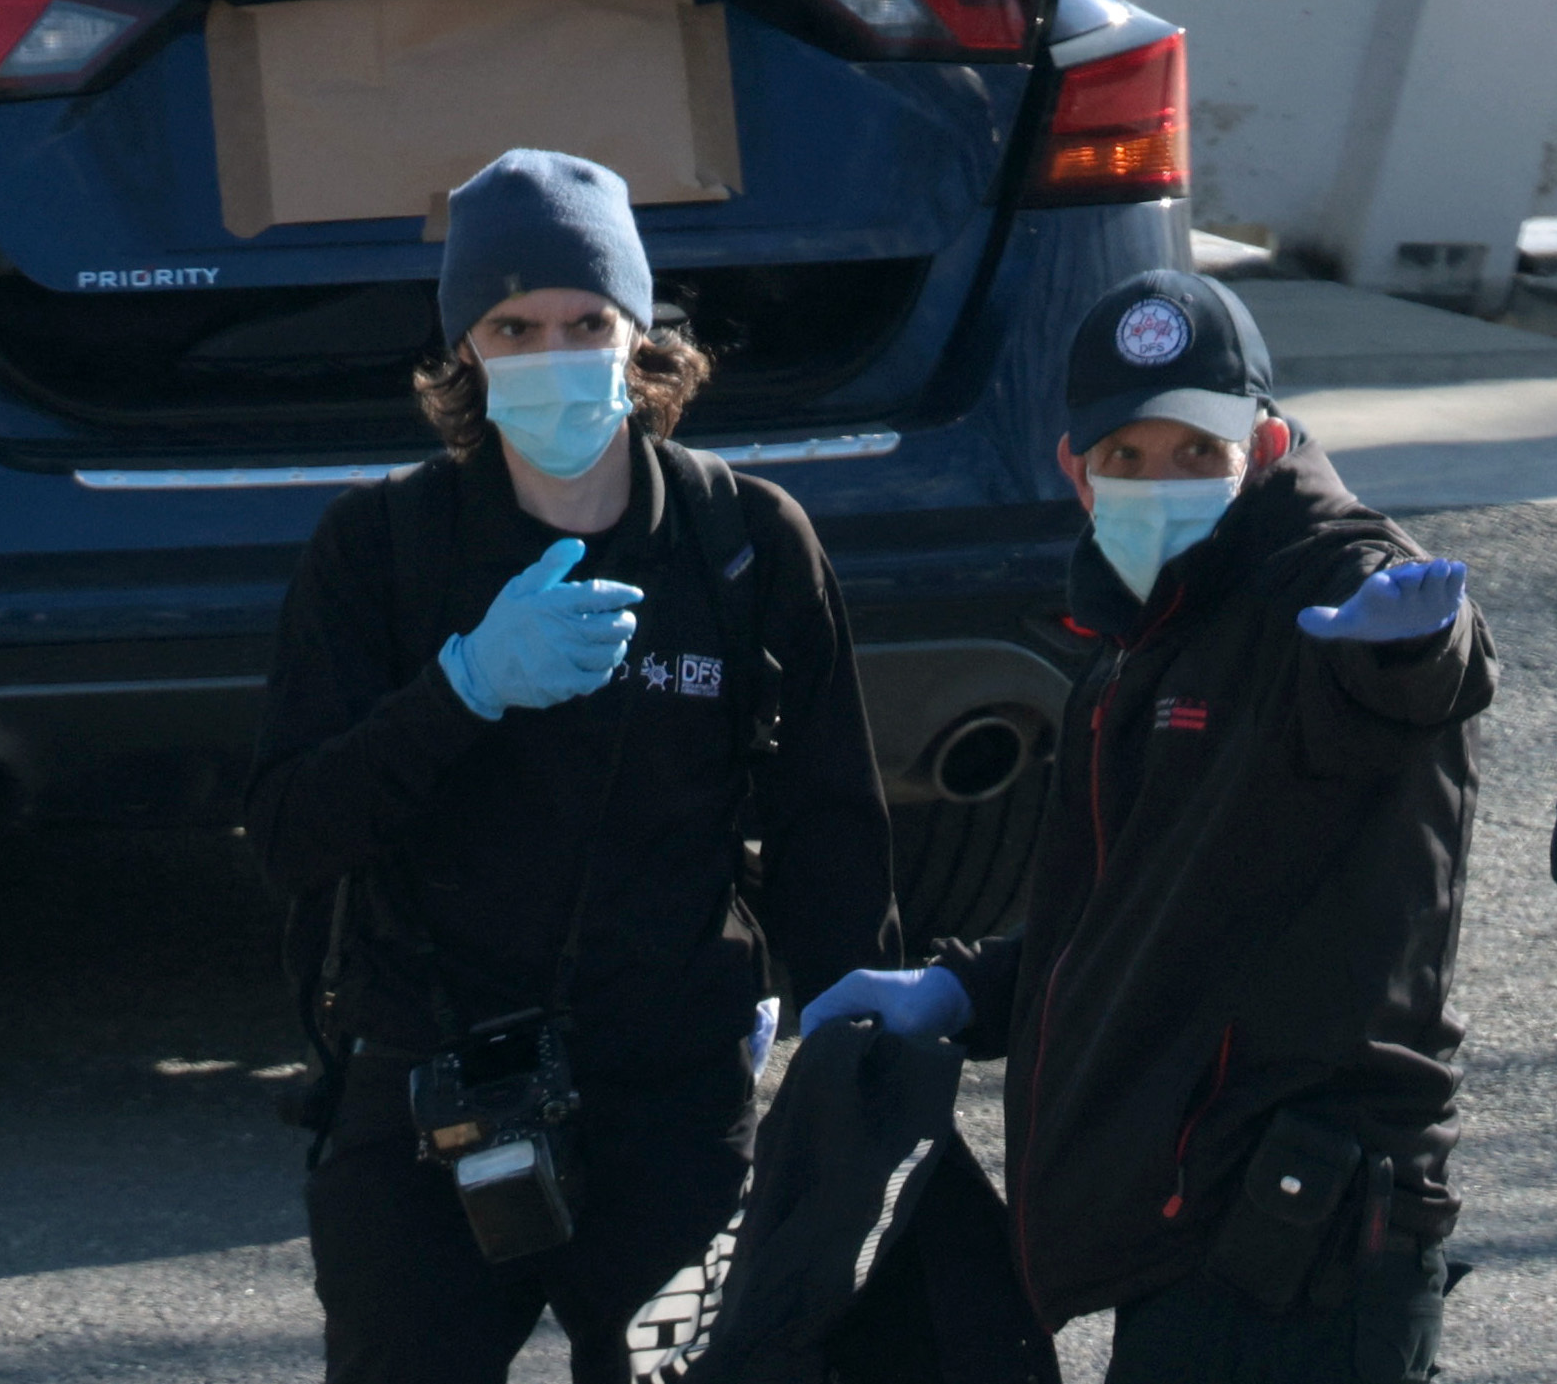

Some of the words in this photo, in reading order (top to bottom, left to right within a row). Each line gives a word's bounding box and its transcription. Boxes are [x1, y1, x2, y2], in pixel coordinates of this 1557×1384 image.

[78, 267, 219, 288] PRIORITY
[1139, 342, 1165, 354] DFS
[681, 660, 722, 686] DFS
